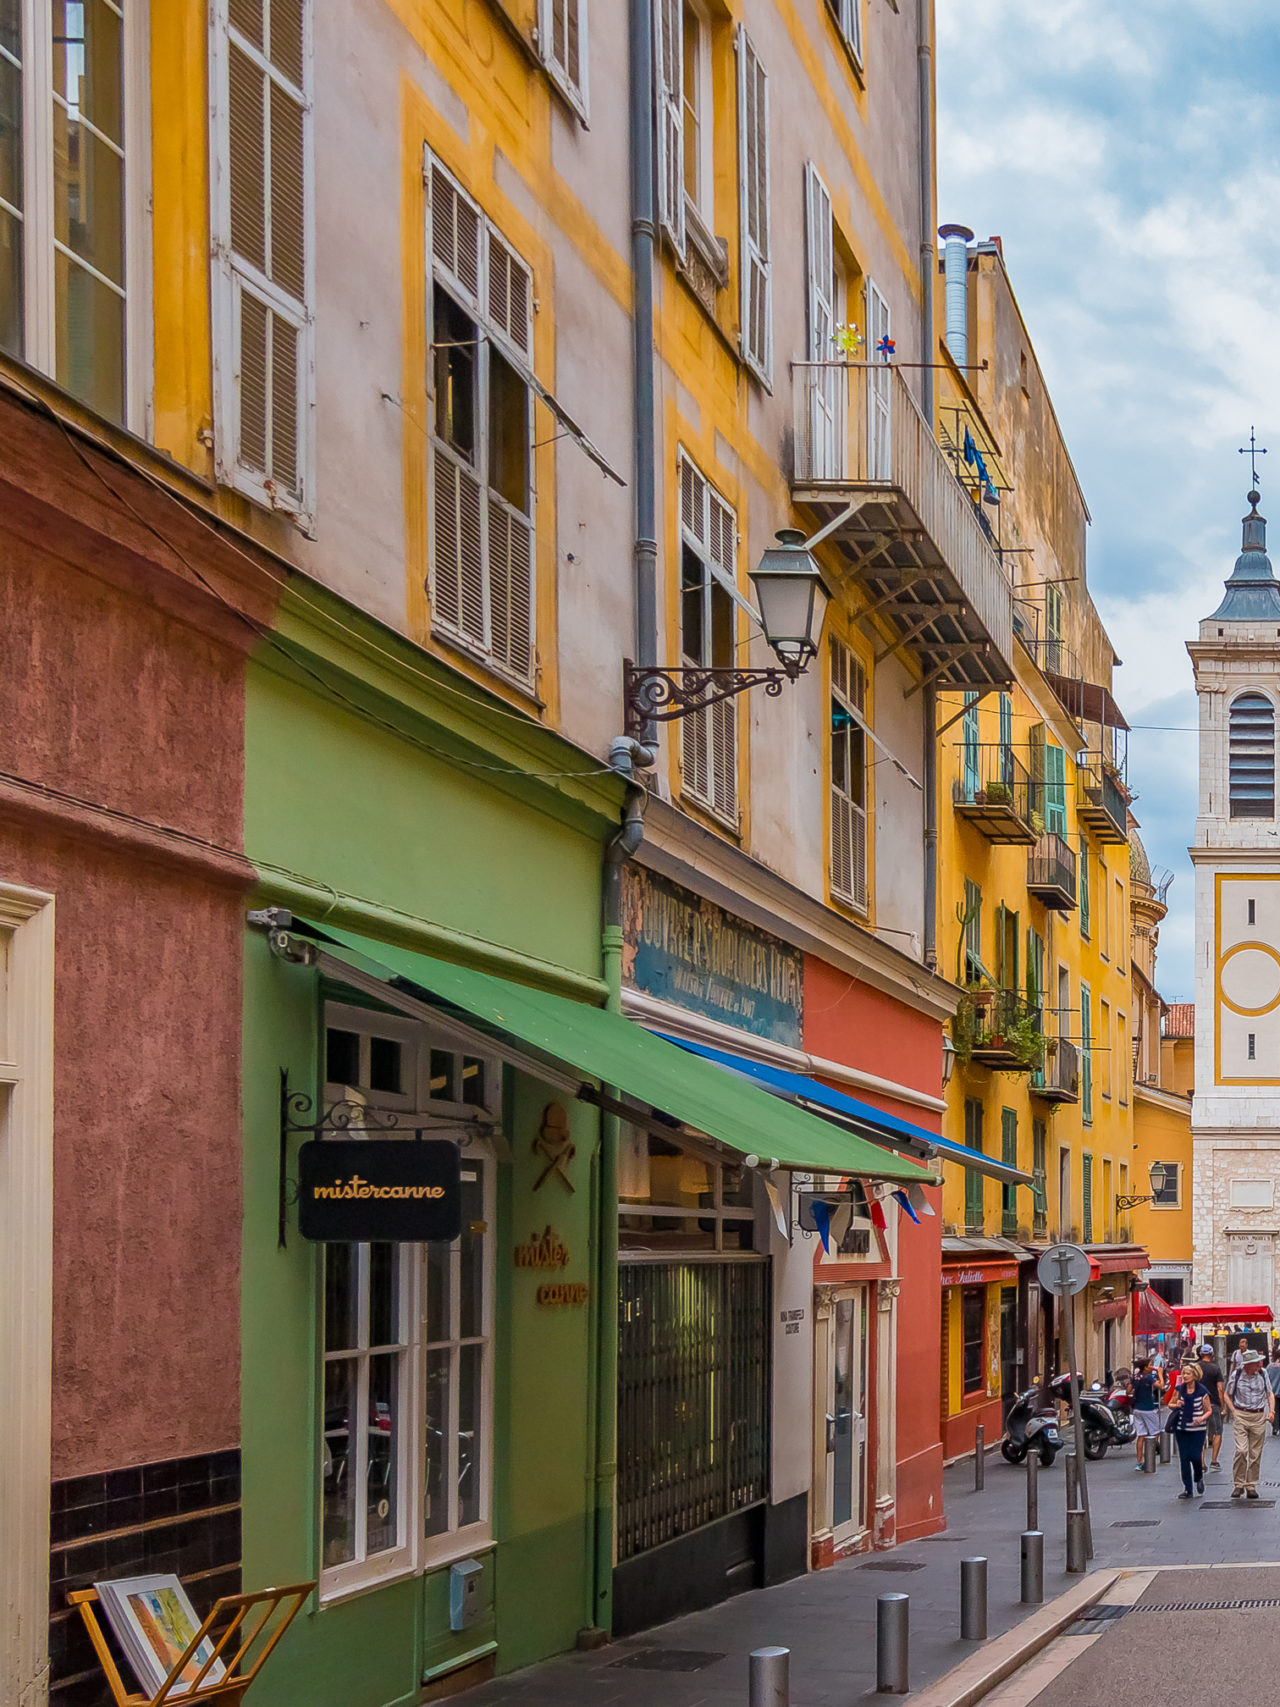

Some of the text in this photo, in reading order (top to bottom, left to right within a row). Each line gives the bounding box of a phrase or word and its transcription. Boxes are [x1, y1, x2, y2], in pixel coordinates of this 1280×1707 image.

[313, 1174, 446, 1200] mistercanne
[513, 1224, 570, 1268] mister
[536, 1284, 588, 1307] canne
